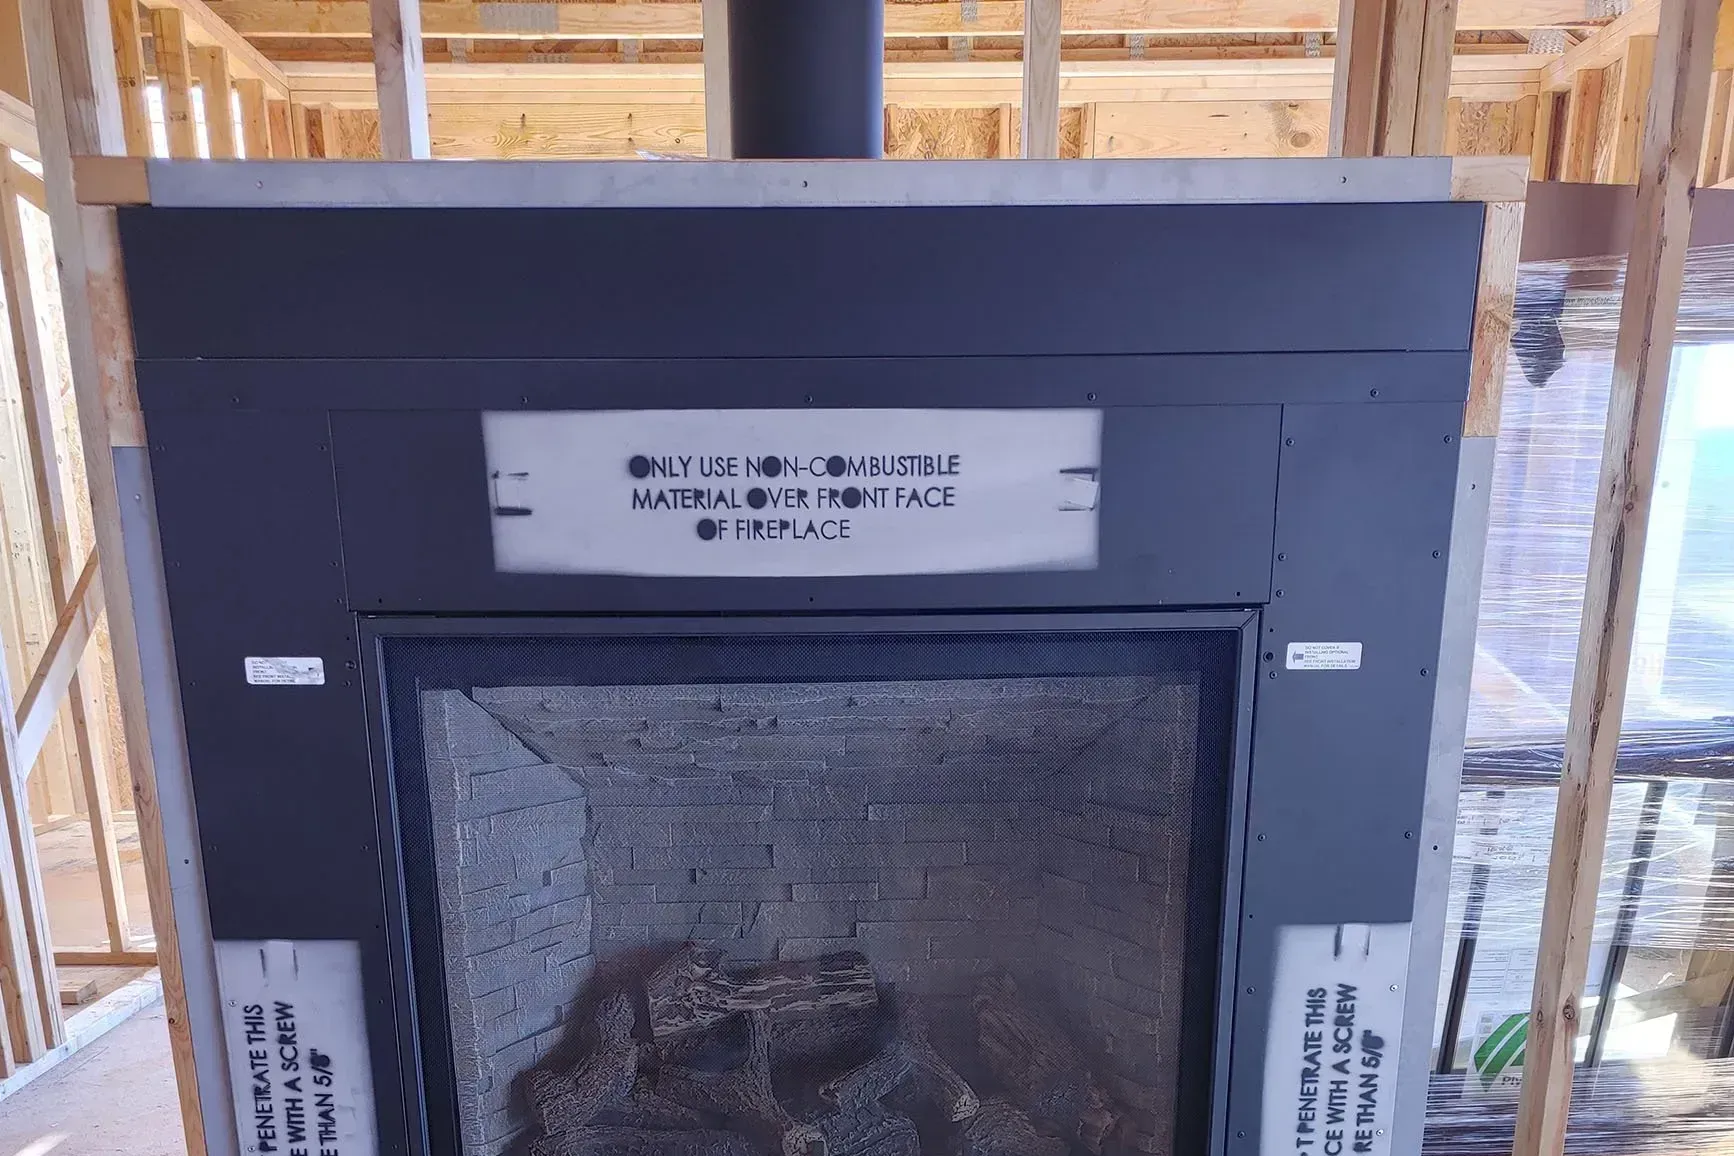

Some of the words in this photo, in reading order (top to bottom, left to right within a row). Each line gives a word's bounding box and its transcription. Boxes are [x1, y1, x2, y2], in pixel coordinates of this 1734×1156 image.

[628, 454, 692, 478] ONLY
[700, 456, 738, 478] USE
[746, 454, 961, 478] NON-COMBUSTIBLE
[632, 486, 741, 510] MATERIAL
[747, 486, 809, 510] OVER
[817, 486, 890, 510] FRONT
[896, 485, 956, 508] FACE
[697, 517, 730, 541] OF
[736, 517, 851, 541] FIREPLACE
[244, 1003, 266, 1045] THIS
[1304, 987, 1327, 1027] THIS
[1332, 983, 1358, 1053] SCREW
[274, 1000, 299, 1072] SCREW
[283, 1076, 303, 1093] A
[1297, 1030, 1323, 1136] PENETRATE
[1332, 1059, 1351, 1075] A
[249, 1049, 277, 1155] PENETRATE
[284, 1098, 306, 1145] WITH
[315, 1093, 334, 1146] THAN
[1326, 1080, 1348, 1125] WITH
[1356, 1073, 1380, 1129] THAN
